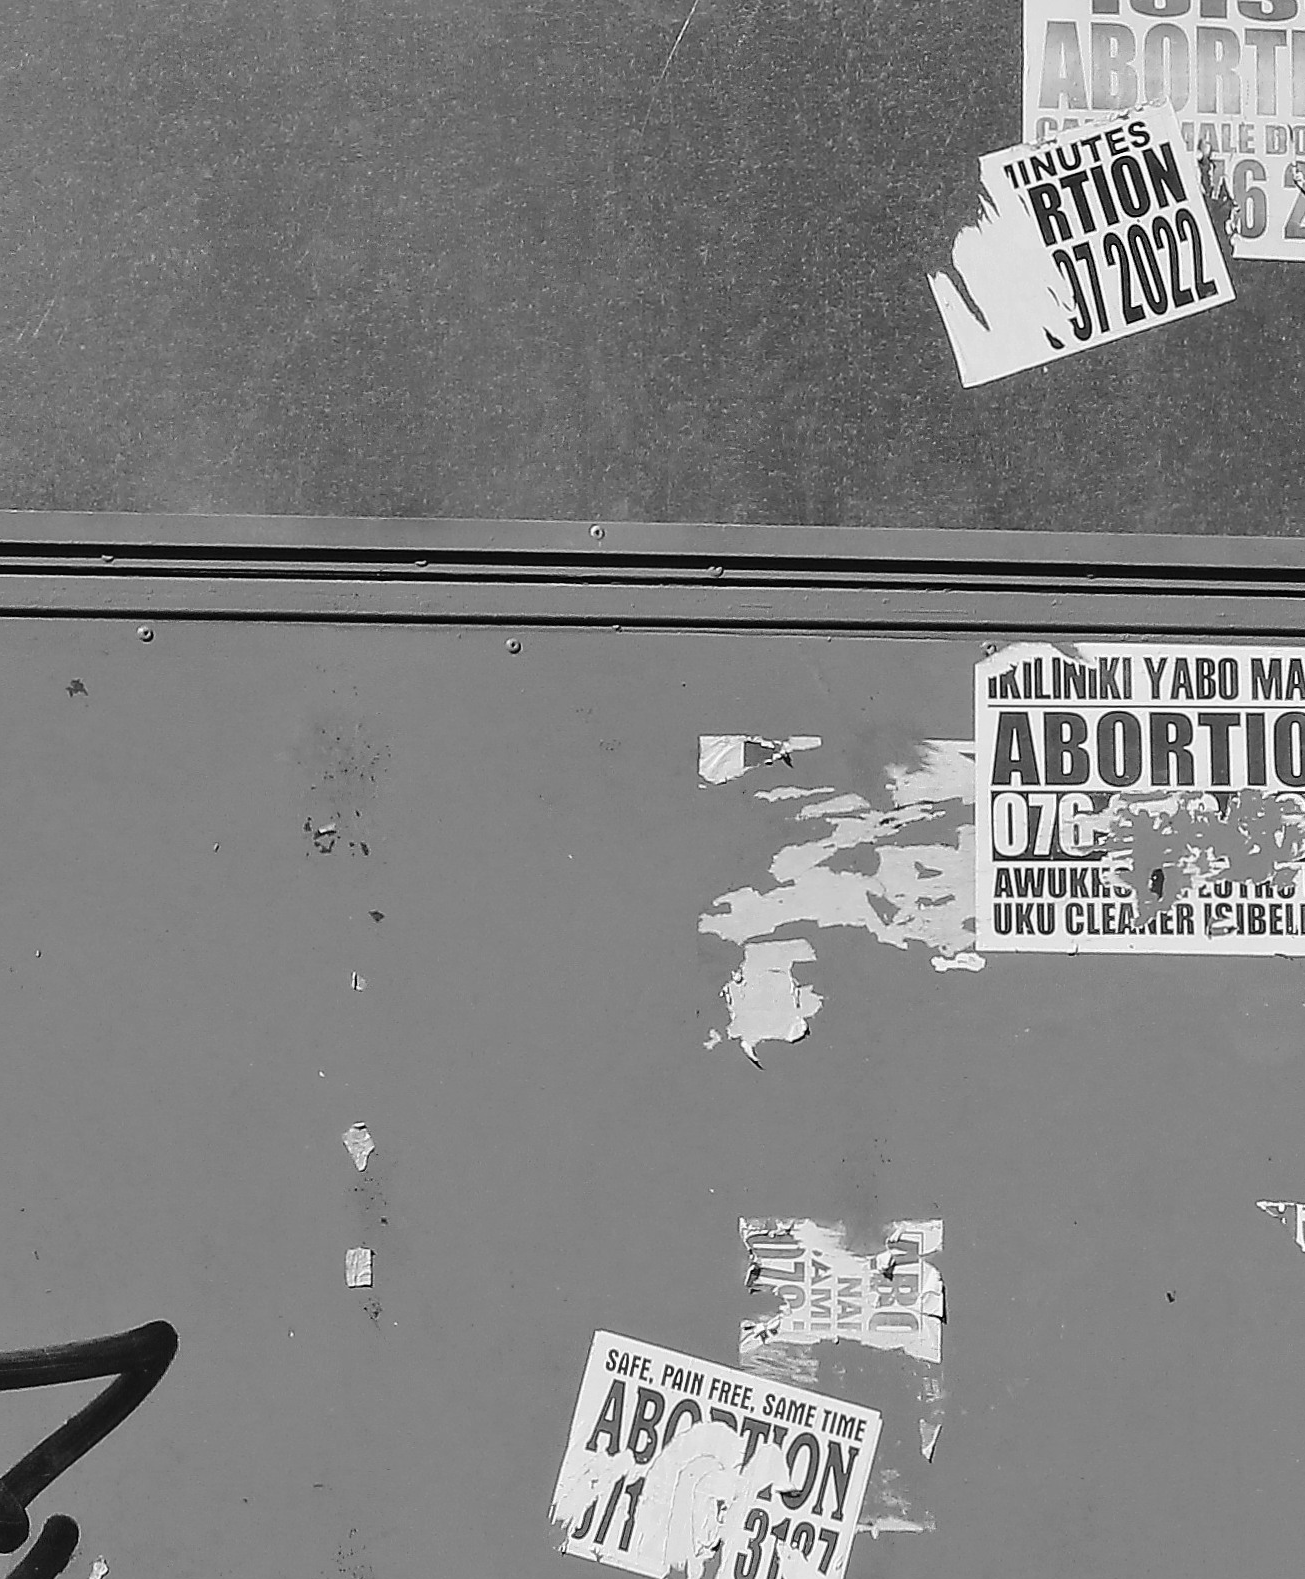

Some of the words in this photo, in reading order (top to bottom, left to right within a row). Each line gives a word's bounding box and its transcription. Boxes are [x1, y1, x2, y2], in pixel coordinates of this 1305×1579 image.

[1027, 142, 1188, 248] RTION
[1103, 207, 1219, 326] 2022
[1144, 657, 1239, 700] YABO
[991, 711, 1305, 787] ABORTIO
[993, 902, 1055, 936] UKU
[1204, 902, 1305, 936] ISIBEL
[605, 1349, 654, 1386] SAFE,
[661, 1365, 704, 1397] PAIN
[708, 1376, 756, 1412] FREE,
[762, 1394, 816, 1427] SAME
[822, 1408, 867, 1442] TIME
